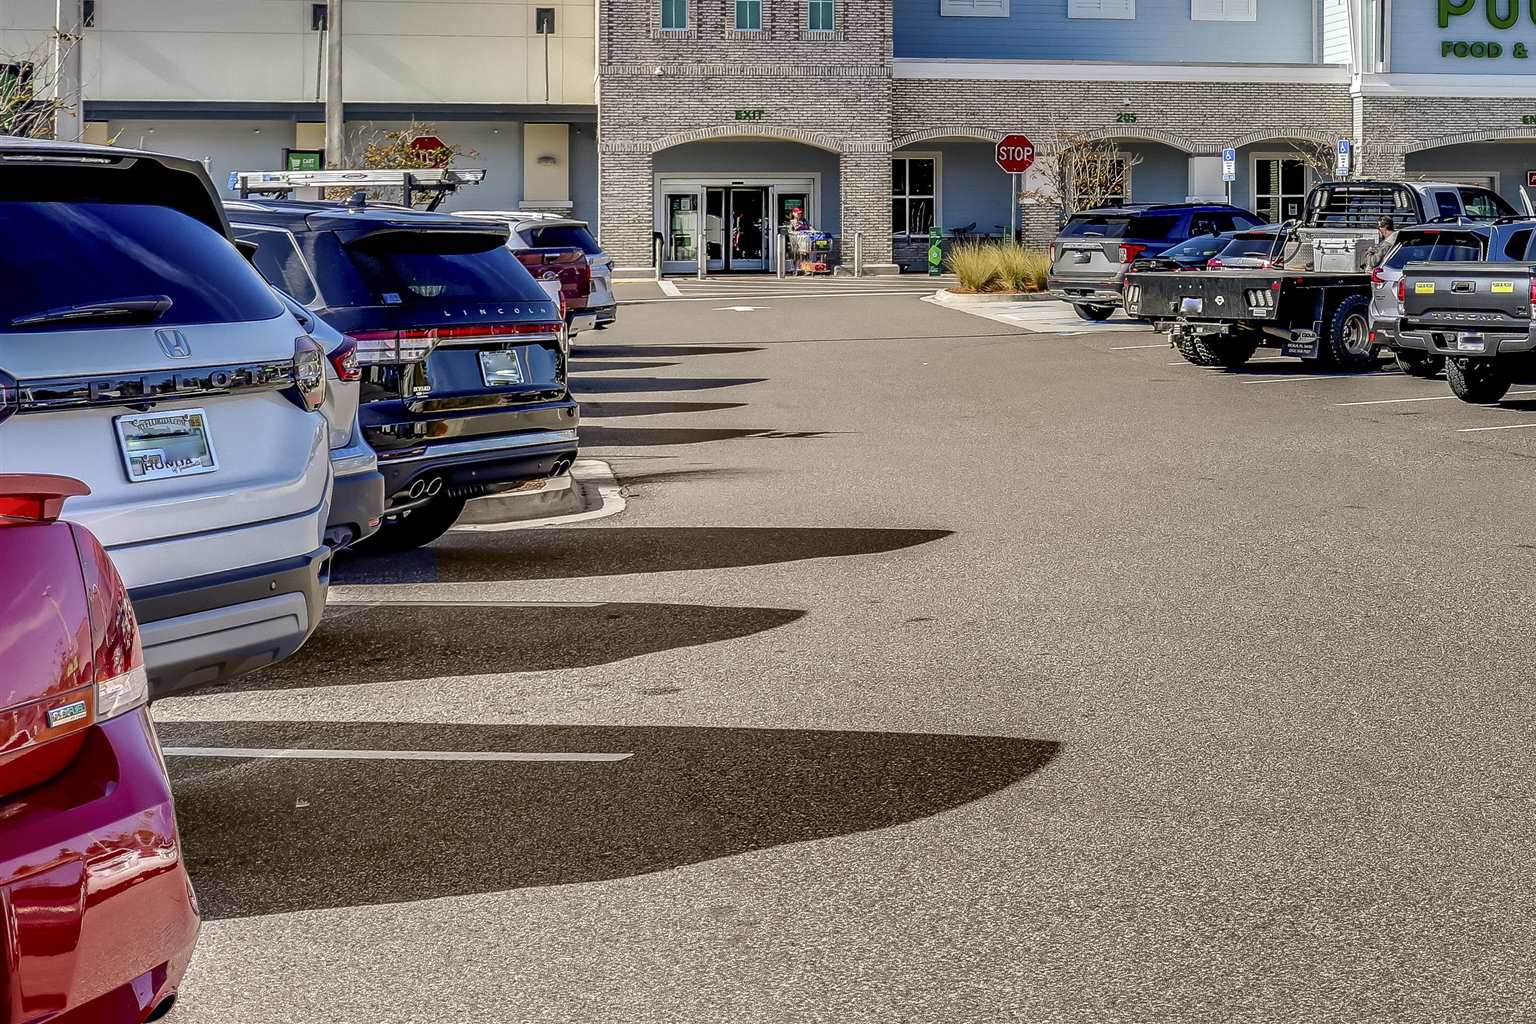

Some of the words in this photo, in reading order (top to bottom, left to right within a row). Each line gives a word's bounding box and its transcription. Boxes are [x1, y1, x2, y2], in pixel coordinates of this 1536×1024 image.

[1441, 41, 1503, 58] FOOD
[1512, 42, 1528, 59] &
[735, 109, 765, 120] EXIT
[1115, 112, 1137, 123] 205
[999, 146, 1033, 161] STOP
[443, 307, 547, 317] LINCOLN
[1431, 312, 1504, 322] TACOMA
[144, 458, 193, 471] HONDA
